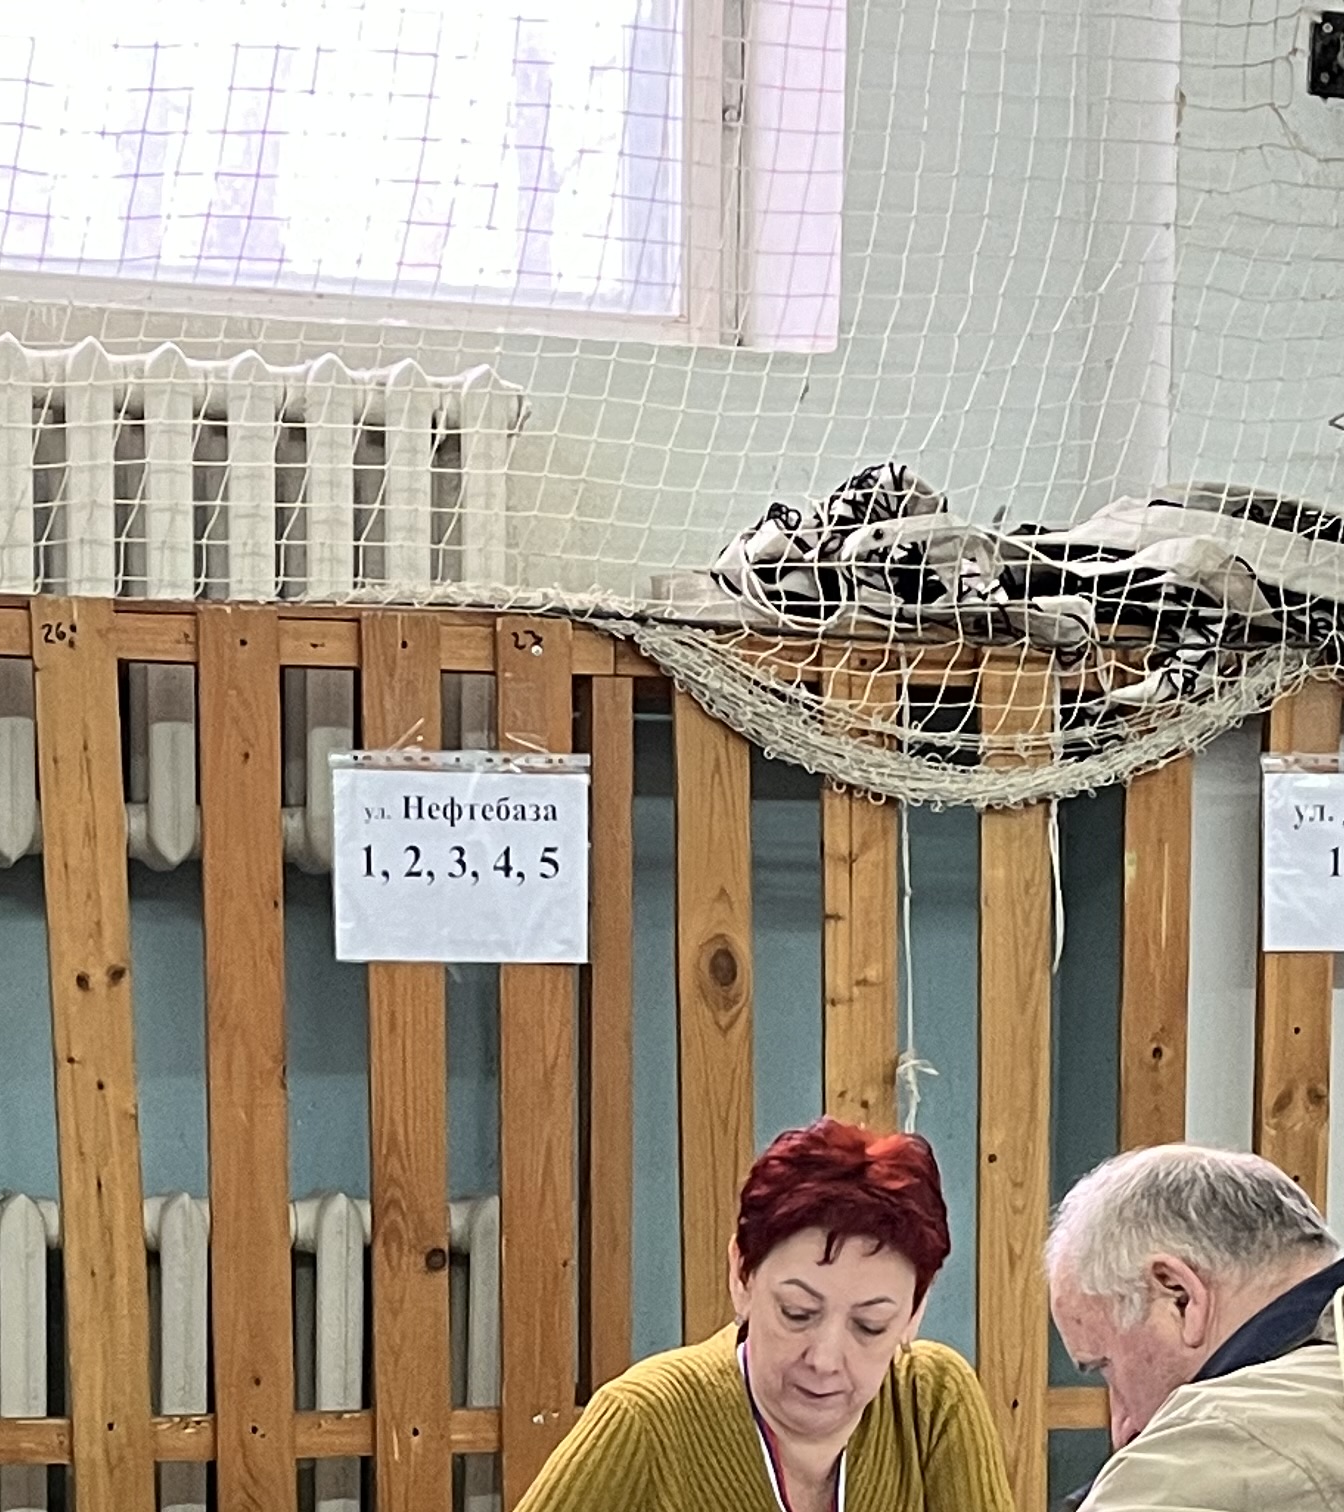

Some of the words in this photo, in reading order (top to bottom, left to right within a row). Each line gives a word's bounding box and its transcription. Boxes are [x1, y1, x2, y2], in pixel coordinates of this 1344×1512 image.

[40, 621, 67, 645] 26
[363, 806, 392, 825] ул.
[402, 795, 558, 828] Нефтебаза
[1293, 804, 1334, 831] ул.
[362, 844, 390, 886] 1,
[403, 845, 436, 886] 2,
[447, 845, 480, 886] 3,
[492, 845, 526, 886] 4,
[539, 846, 560, 880] 5
